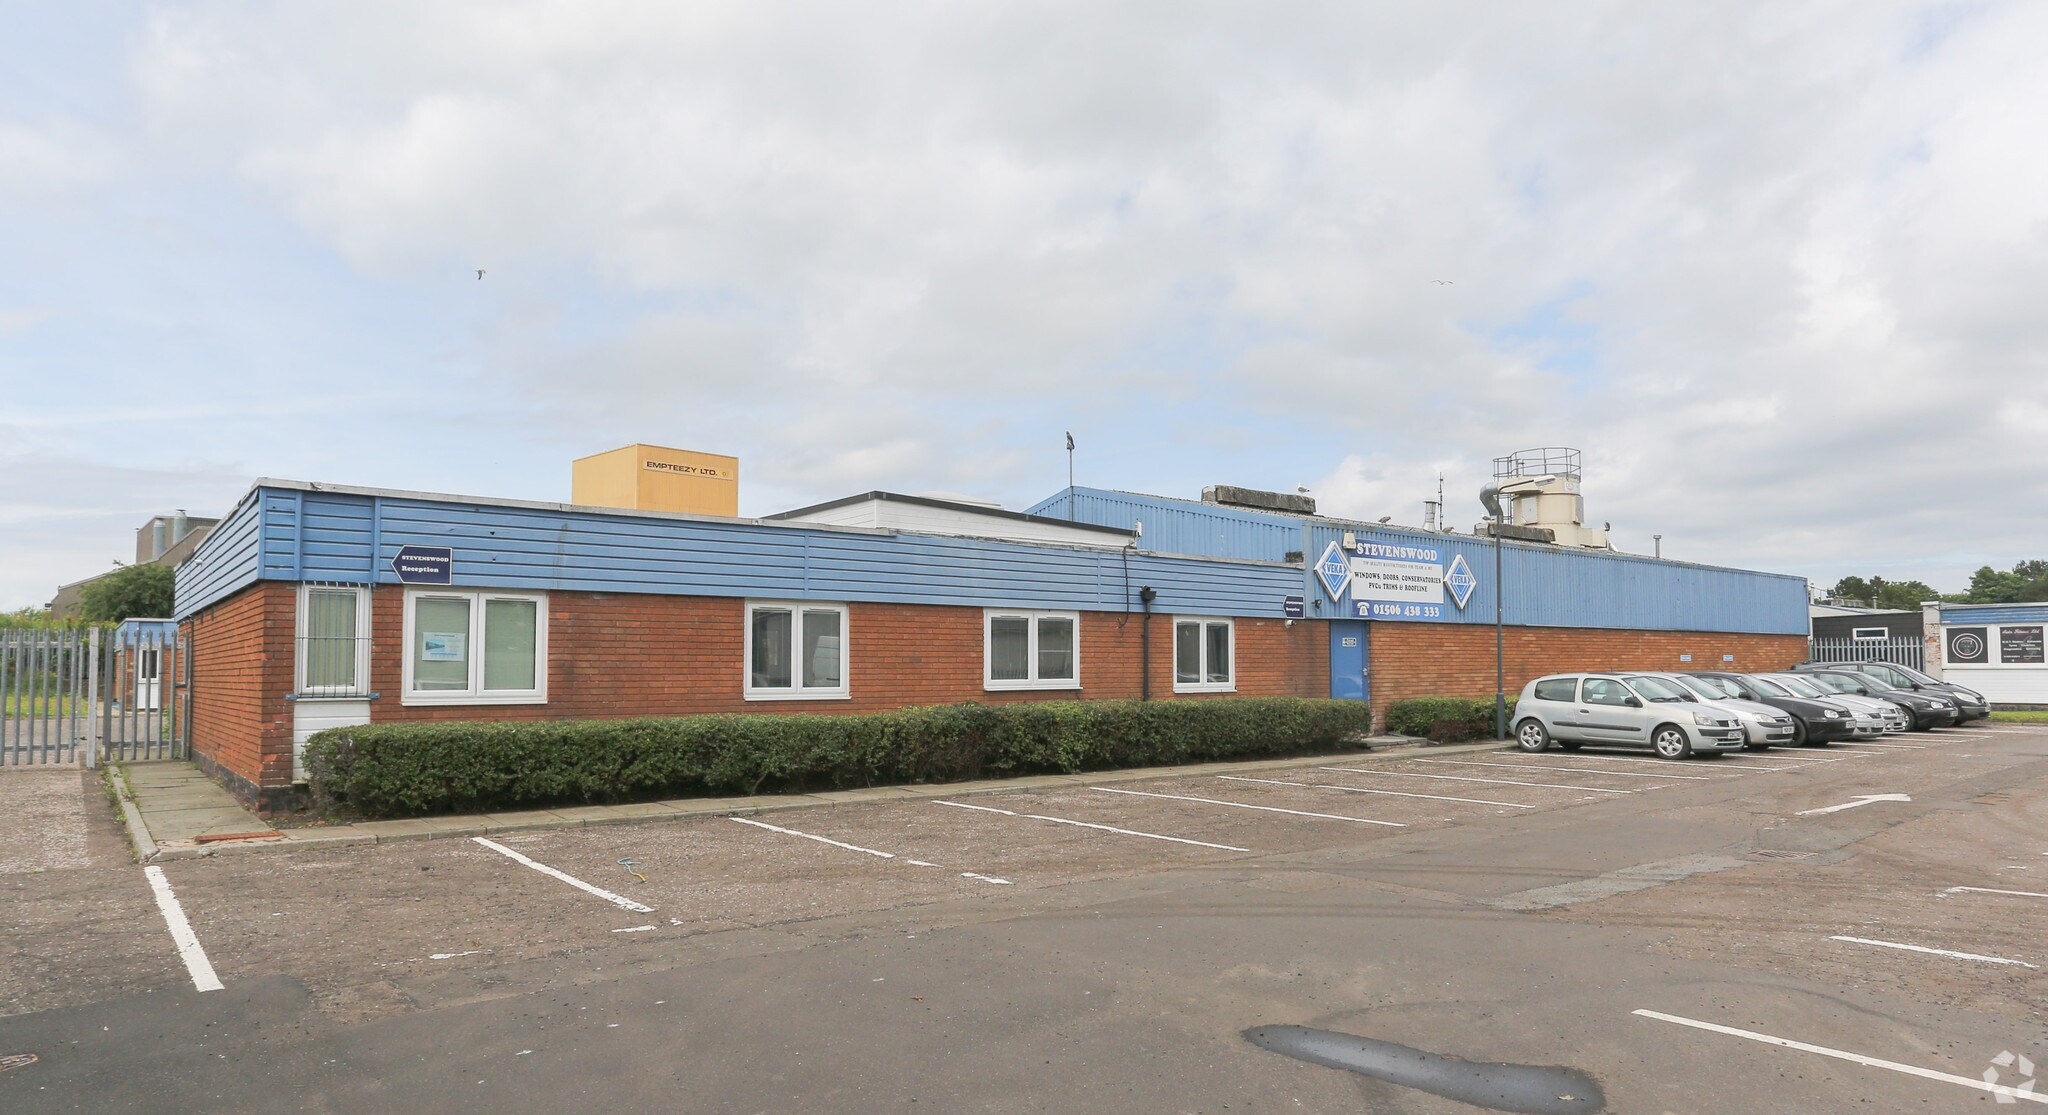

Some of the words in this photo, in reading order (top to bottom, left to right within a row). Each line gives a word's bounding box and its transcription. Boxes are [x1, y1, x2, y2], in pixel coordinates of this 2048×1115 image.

[646, 461, 697, 473] EMPTEEZY
[1357, 542, 1438, 561] STEVENSWOOD
[401, 565, 439, 573] Reception
[1326, 563, 1343, 574] VEKA
[1401, 574, 1441, 584] CONSERVATORIES
[1454, 575, 1468, 584] VEKA
[1383, 583, 1398, 591] TRIMS
[1405, 584, 1427, 592] ROOFLINE
[1373, 603, 1401, 615] 01506
[1404, 605, 1421, 617] 438
[1424, 606, 1440, 617] 333
